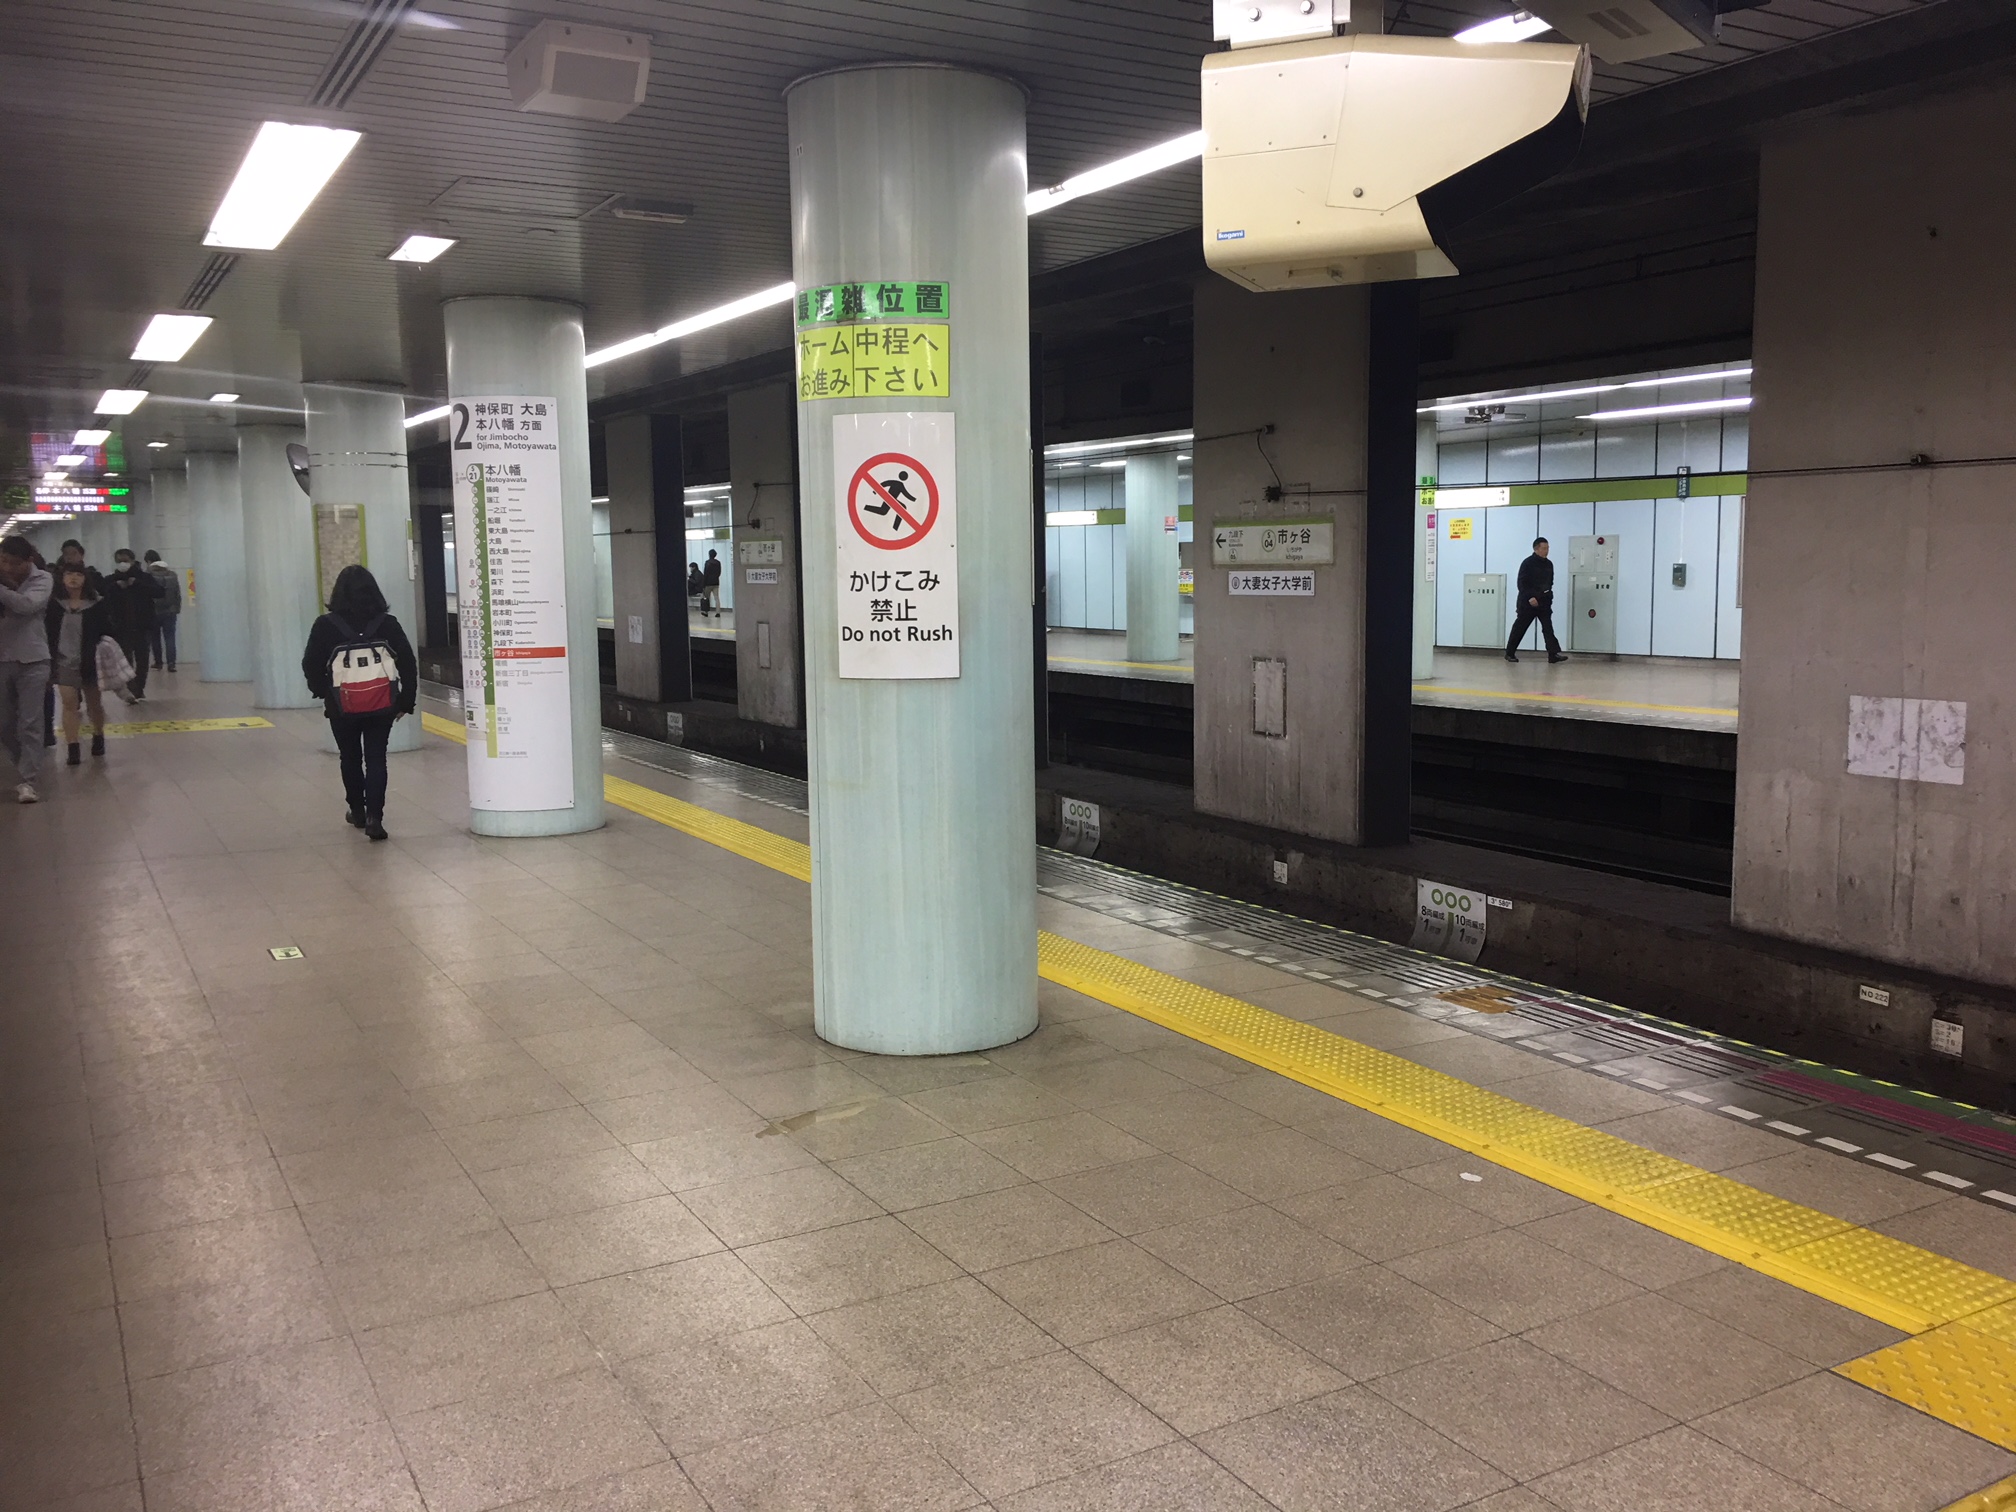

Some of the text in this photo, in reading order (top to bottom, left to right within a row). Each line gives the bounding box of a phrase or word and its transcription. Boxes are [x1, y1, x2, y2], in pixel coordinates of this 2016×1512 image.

[1218, 230, 1244, 240] Ikegami
[800, 327, 939, 361] ホーム中程へ
[800, 366, 938, 398] お進み下さい
[475, 403, 547, 416] 神保町 大島
[453, 403, 472, 450] 2
[476, 418, 542, 431] 本八幡 方面
[476, 433, 529, 441] for Jimbocho
[477, 442, 557, 451] Ojima, Motoyawata
[469, 472, 477, 480] 21
[485, 464, 521, 476] 本八幡
[1278, 528, 1311, 544] 市ヶ谷
[1264, 540, 1273, 548] 04
[850, 570, 940, 592] かけこみ
[1242, 576, 1312, 591] 大妻女子大学前
[870, 599, 917, 622] 禁止
[842, 624, 953, 642] Do not Rush
[494, 639, 513, 647] 九段下
[1455, 914, 1486, 931] 10両編成
